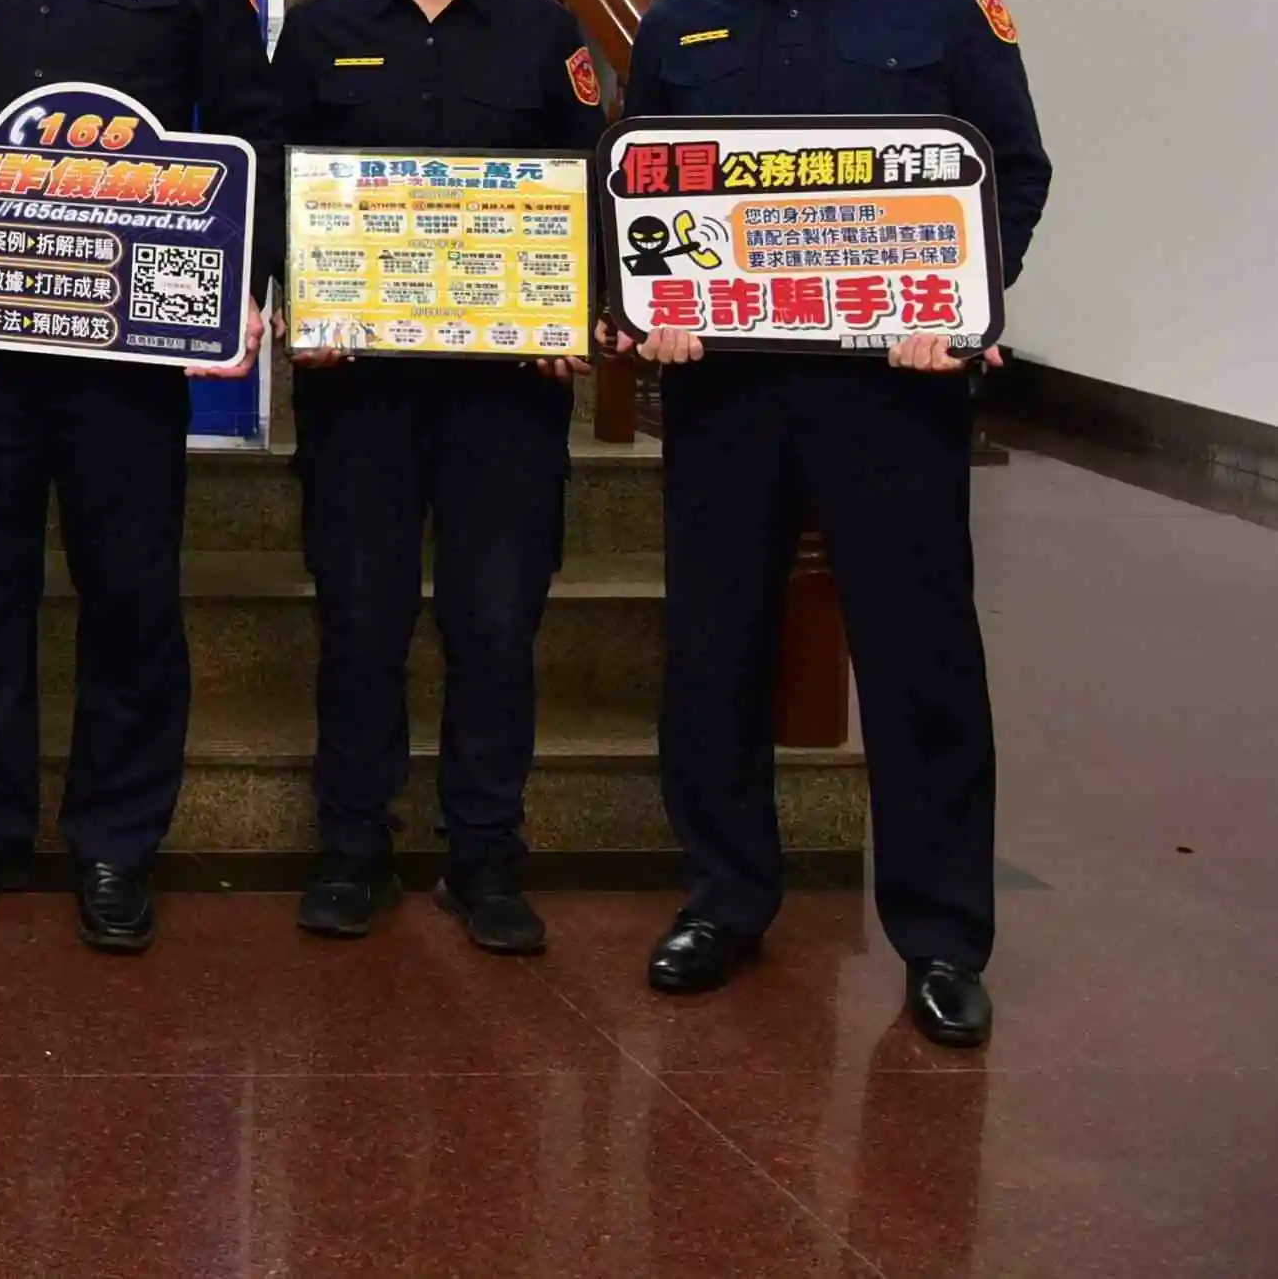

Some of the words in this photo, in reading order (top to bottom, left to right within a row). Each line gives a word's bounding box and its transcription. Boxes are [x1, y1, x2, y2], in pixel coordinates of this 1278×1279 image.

[38, 111, 139, 151] 165
[621, 142, 874, 194] 假冒公務機關
[881, 144, 963, 183] 詐騙
[36, 234, 114, 260] 拆解詐騙
[747, 224, 957, 247] 請配合製作電話調查筆錄
[747, 246, 958, 268] 要求匯款至指定帳戶保管
[35, 273, 113, 299] 打詐成果
[649, 274, 961, 330] 是詐騙手法
